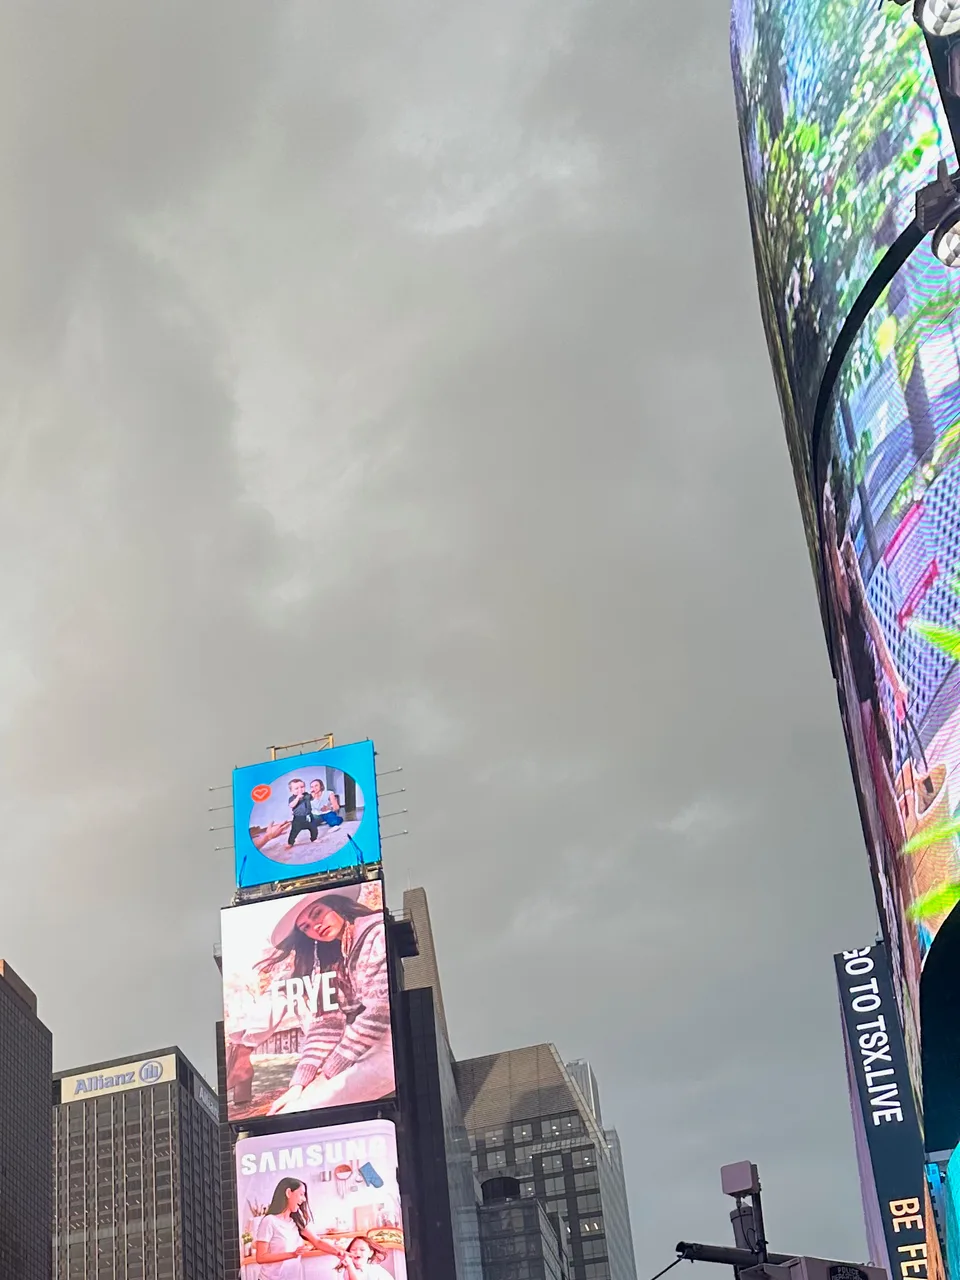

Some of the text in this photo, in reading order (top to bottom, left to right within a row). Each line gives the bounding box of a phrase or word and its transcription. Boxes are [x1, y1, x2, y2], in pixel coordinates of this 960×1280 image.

[271, 971, 339, 1017] FRYE
[849, 977, 882, 1013] TO
[74, 1070, 136, 1095] Allianz
[856, 1014, 904, 1126] TSX.LIVE
[241, 1135, 388, 1177] SAMSUNG
[889, 1197, 924, 1233] BE
[838, 1266, 859, 1276] POLICE
